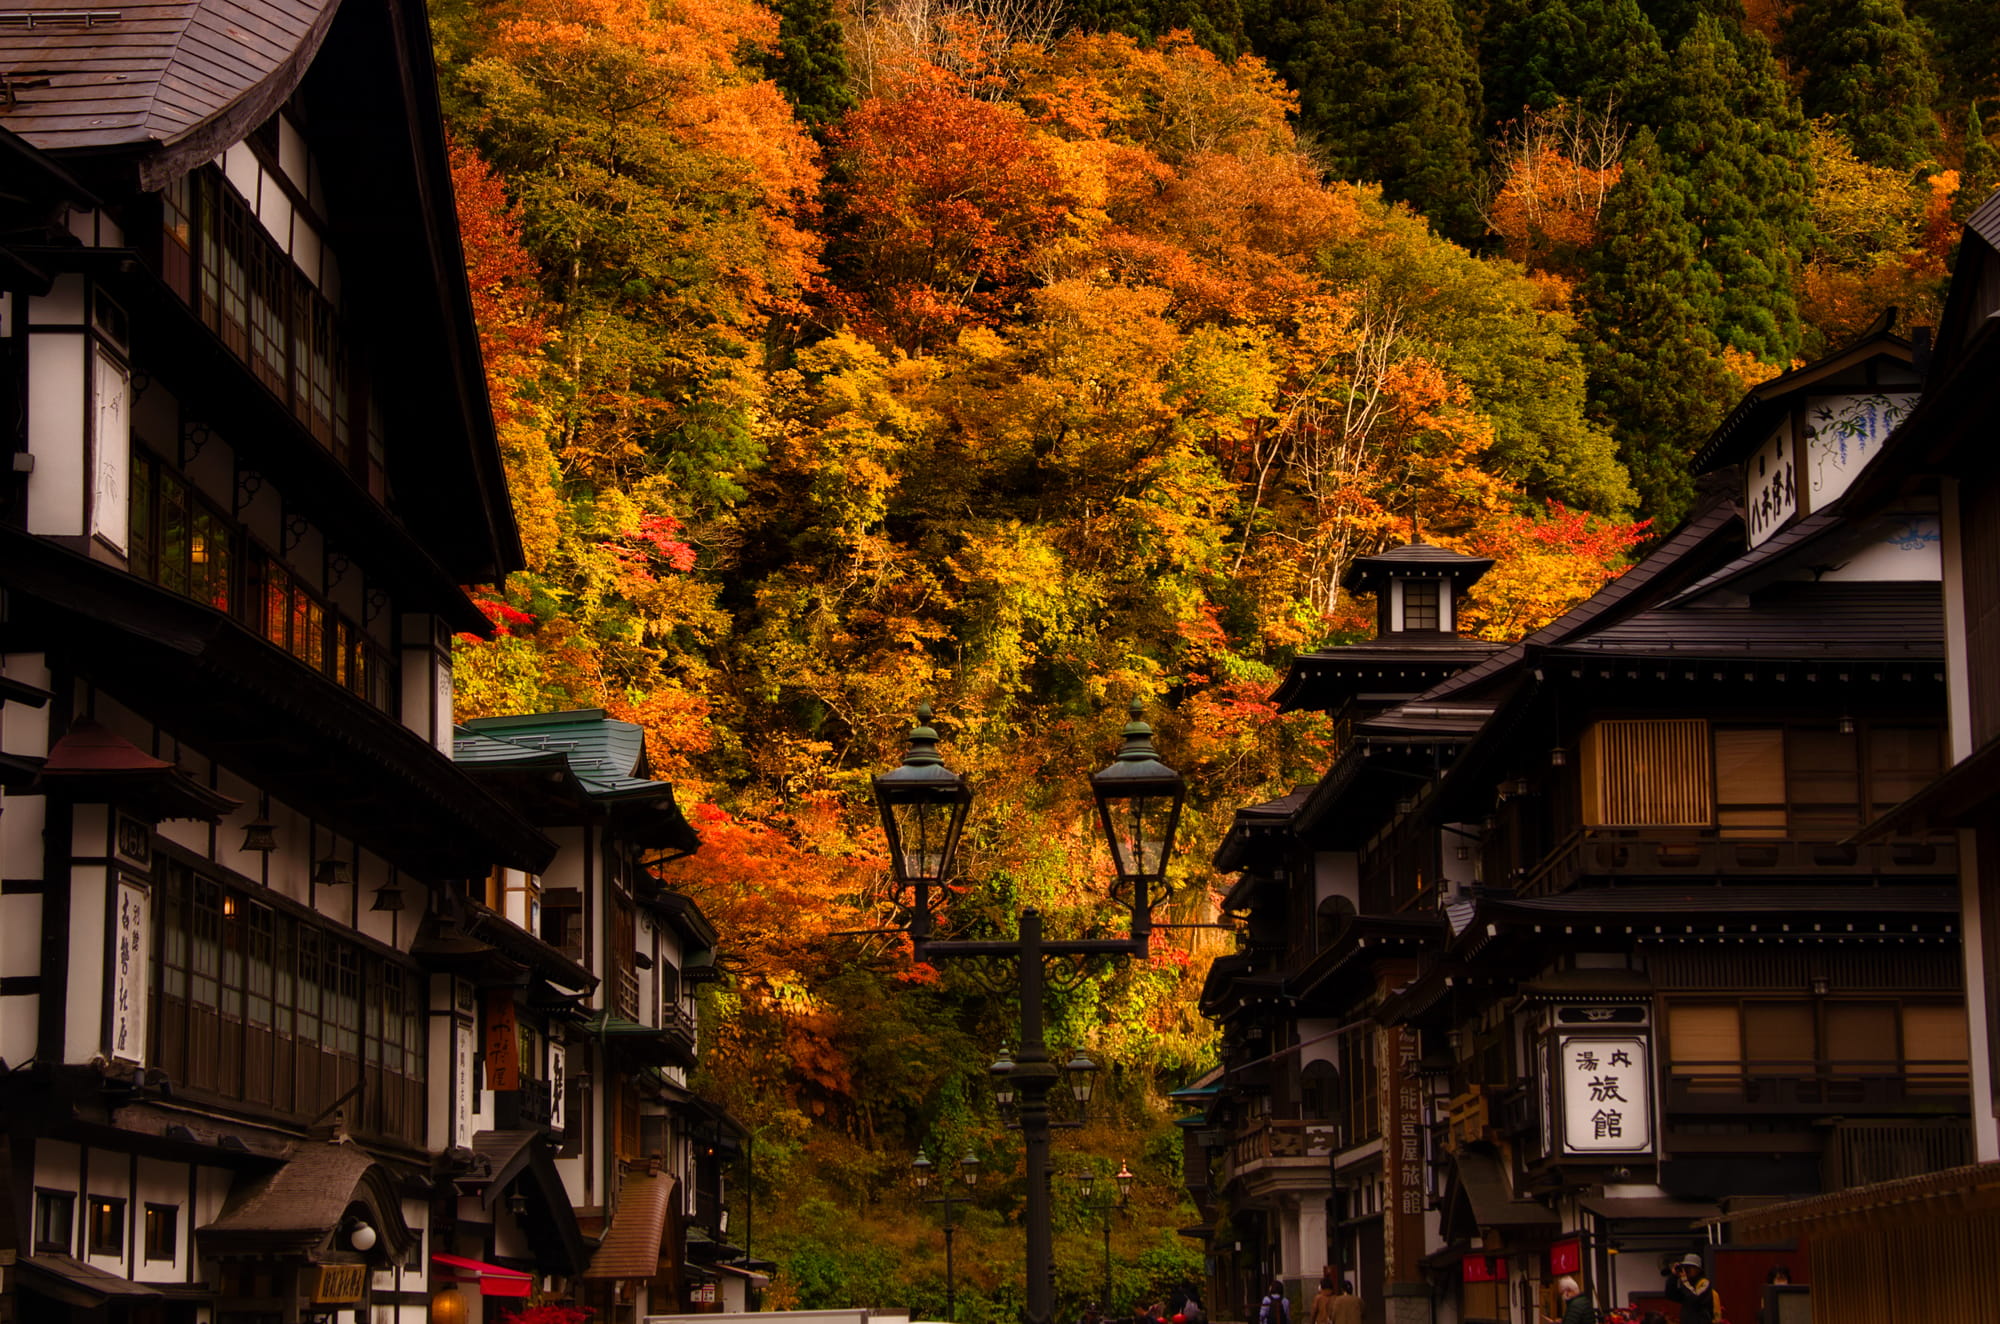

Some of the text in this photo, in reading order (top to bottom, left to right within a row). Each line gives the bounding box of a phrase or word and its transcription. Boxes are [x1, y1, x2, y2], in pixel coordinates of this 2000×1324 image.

[1400, 1087, 1422, 1215] 能登屋旅館
[1588, 1075, 1628, 1140] 旅館
